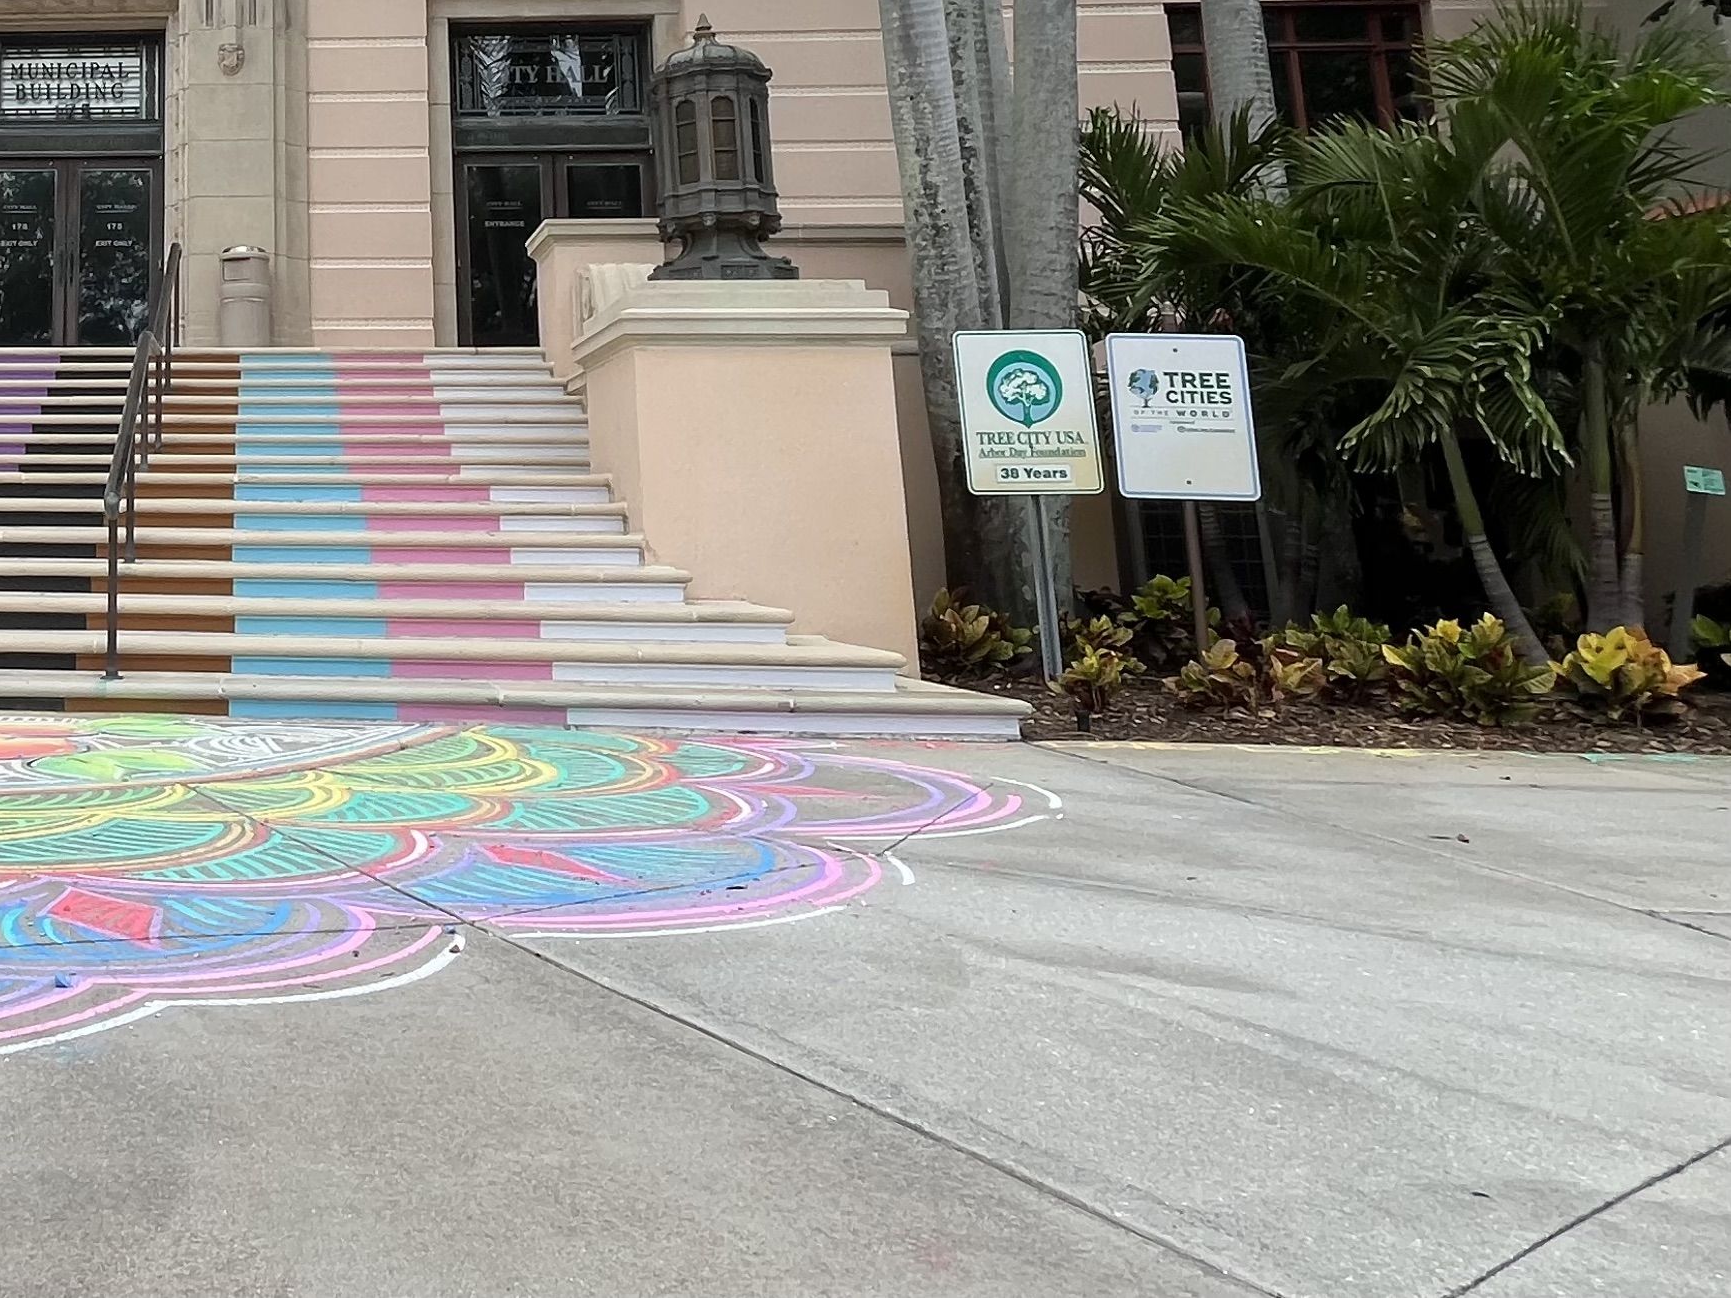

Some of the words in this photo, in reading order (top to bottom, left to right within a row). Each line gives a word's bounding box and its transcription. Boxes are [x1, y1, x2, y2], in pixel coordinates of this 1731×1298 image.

[10, 62, 129, 80] MUNICIPAL
[15, 82, 124, 101] BUILDING
[1163, 371, 1231, 389] TREE
[1166, 390, 1233, 405] CITIES
[1176, 410, 1231, 419] WORLD
[976, 431, 1015, 445] TREE
[1017, 430, 1052, 446] CITY
[1055, 430, 1085, 445] USA
[1009, 447, 1028, 460] Day
[1030, 446, 1087, 458] Foundation
[1000, 467, 1020, 480] 38
[1023, 467, 1069, 480] Years
